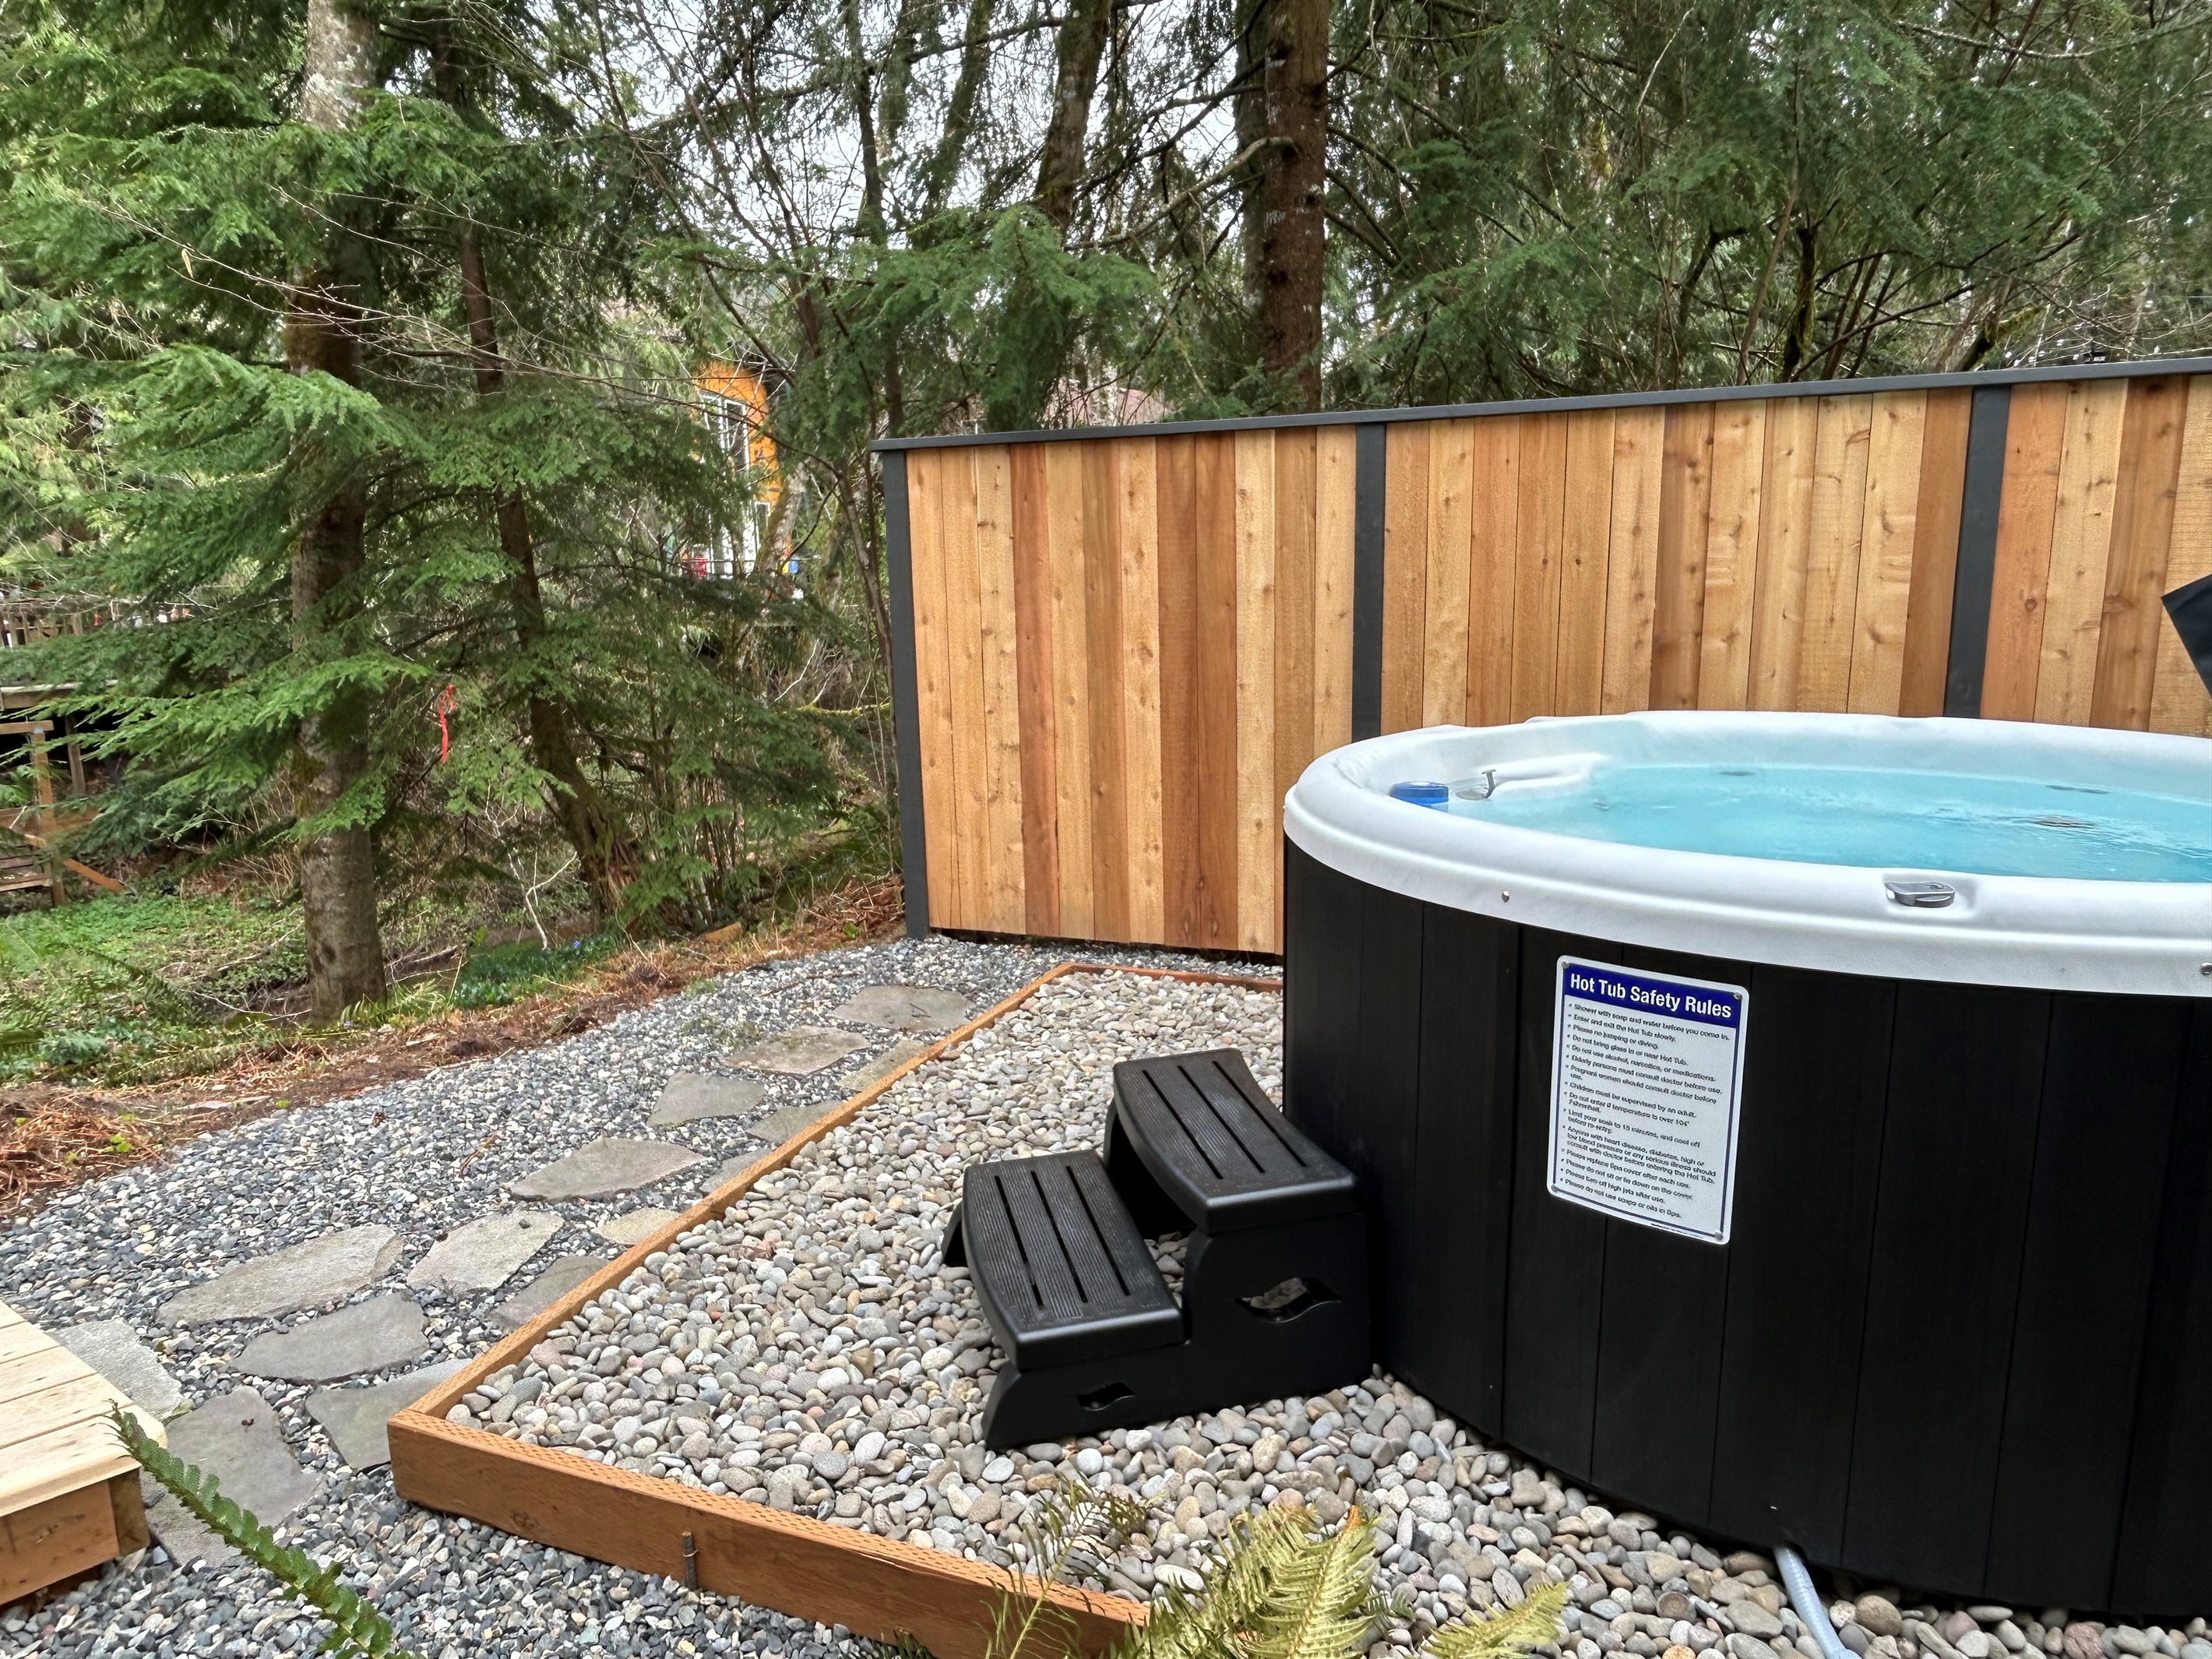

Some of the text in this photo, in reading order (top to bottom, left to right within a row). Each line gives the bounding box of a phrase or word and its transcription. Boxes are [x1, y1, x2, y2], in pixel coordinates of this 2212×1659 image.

[1570, 973, 1731, 1017] Hot Tub Safety Rules
[1627, 1026, 1640, 1034] Hot
[1572, 1044, 1581, 1052] Do
[1572, 1034, 1582, 1042] Do
[1660, 1054, 1672, 1063] Hot
[1569, 1091, 1578, 1100] Do
[1657, 1104, 1666, 1113] by
[1686, 1171, 1700, 1181] Hot
